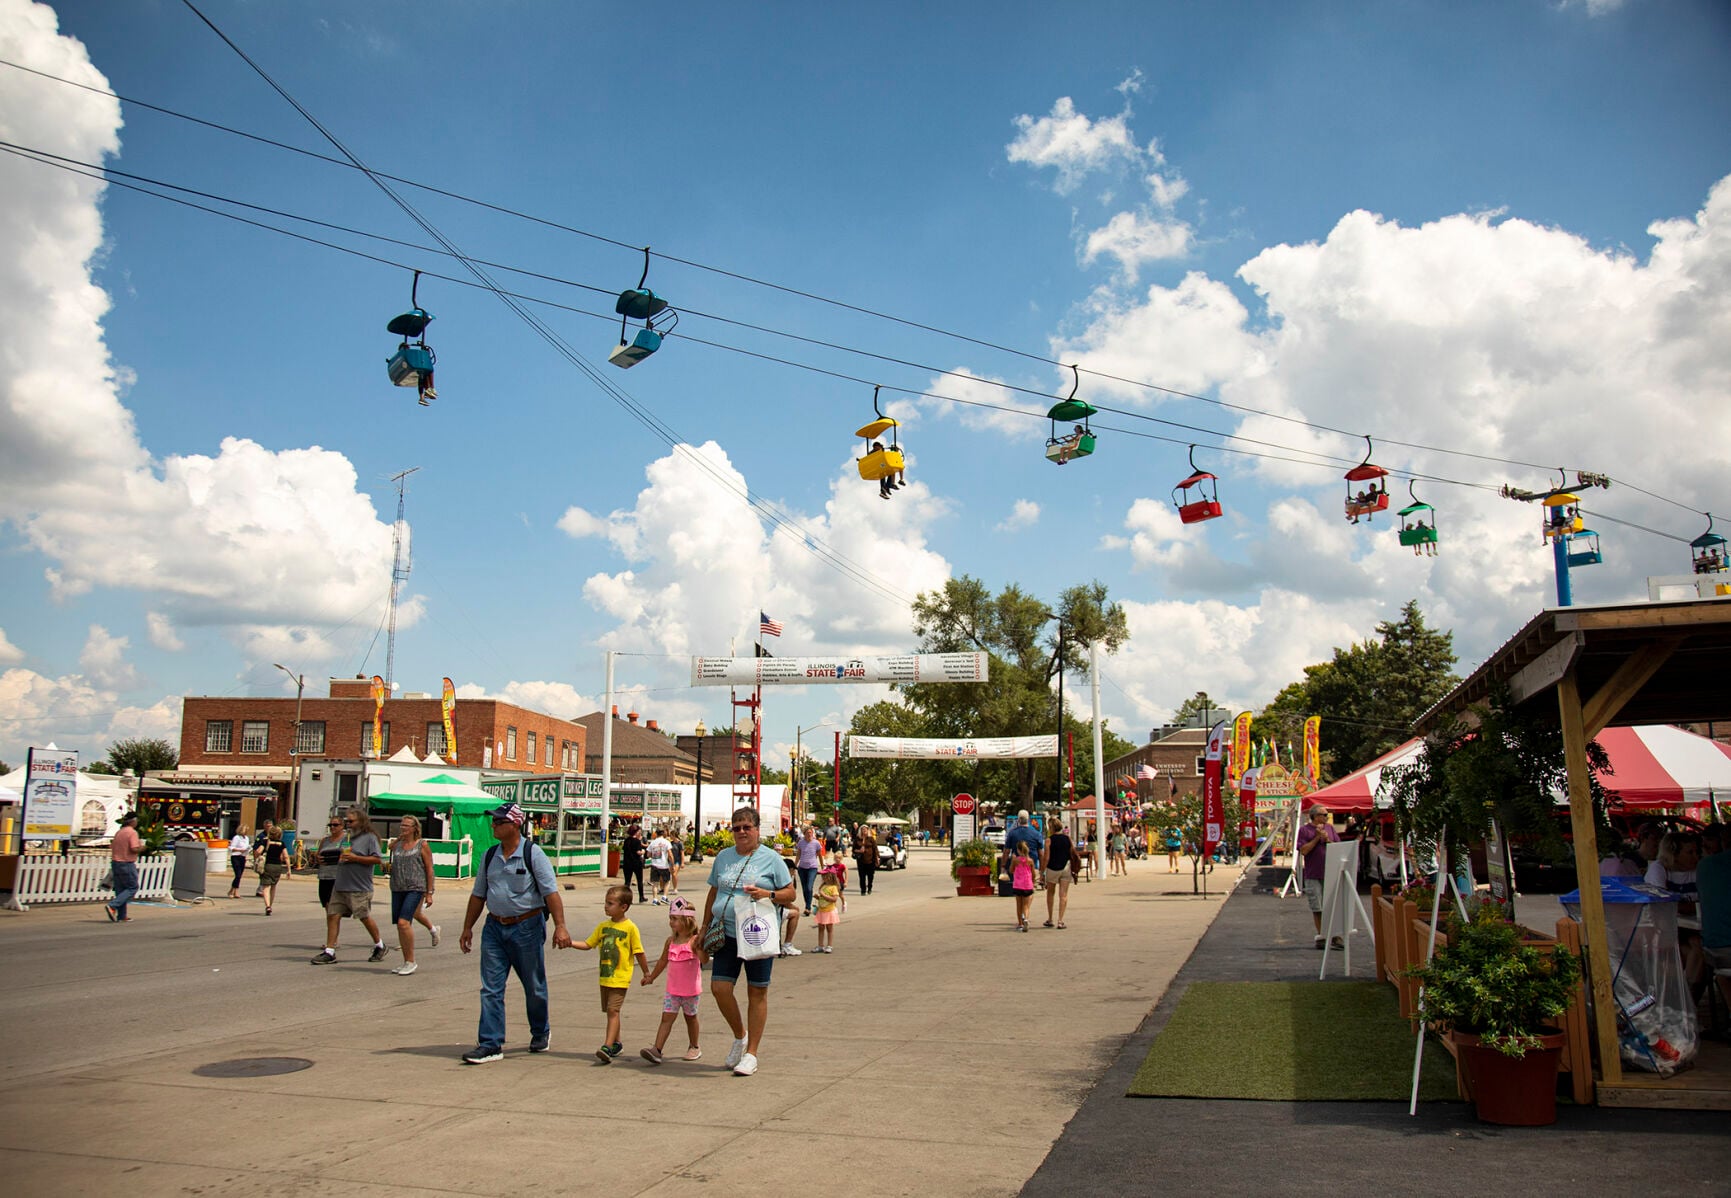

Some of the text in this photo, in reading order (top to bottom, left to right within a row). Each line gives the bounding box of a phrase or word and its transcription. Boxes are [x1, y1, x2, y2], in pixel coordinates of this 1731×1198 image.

[806, 669, 836, 677] STATE
[843, 669, 866, 677] FAIR
[32, 763, 77, 773] STATE FAIR
[483, 783, 557, 802] TURKEY LEGS
[565, 781, 603, 795] TURKEY LEG
[954, 800, 973, 809] STOP
